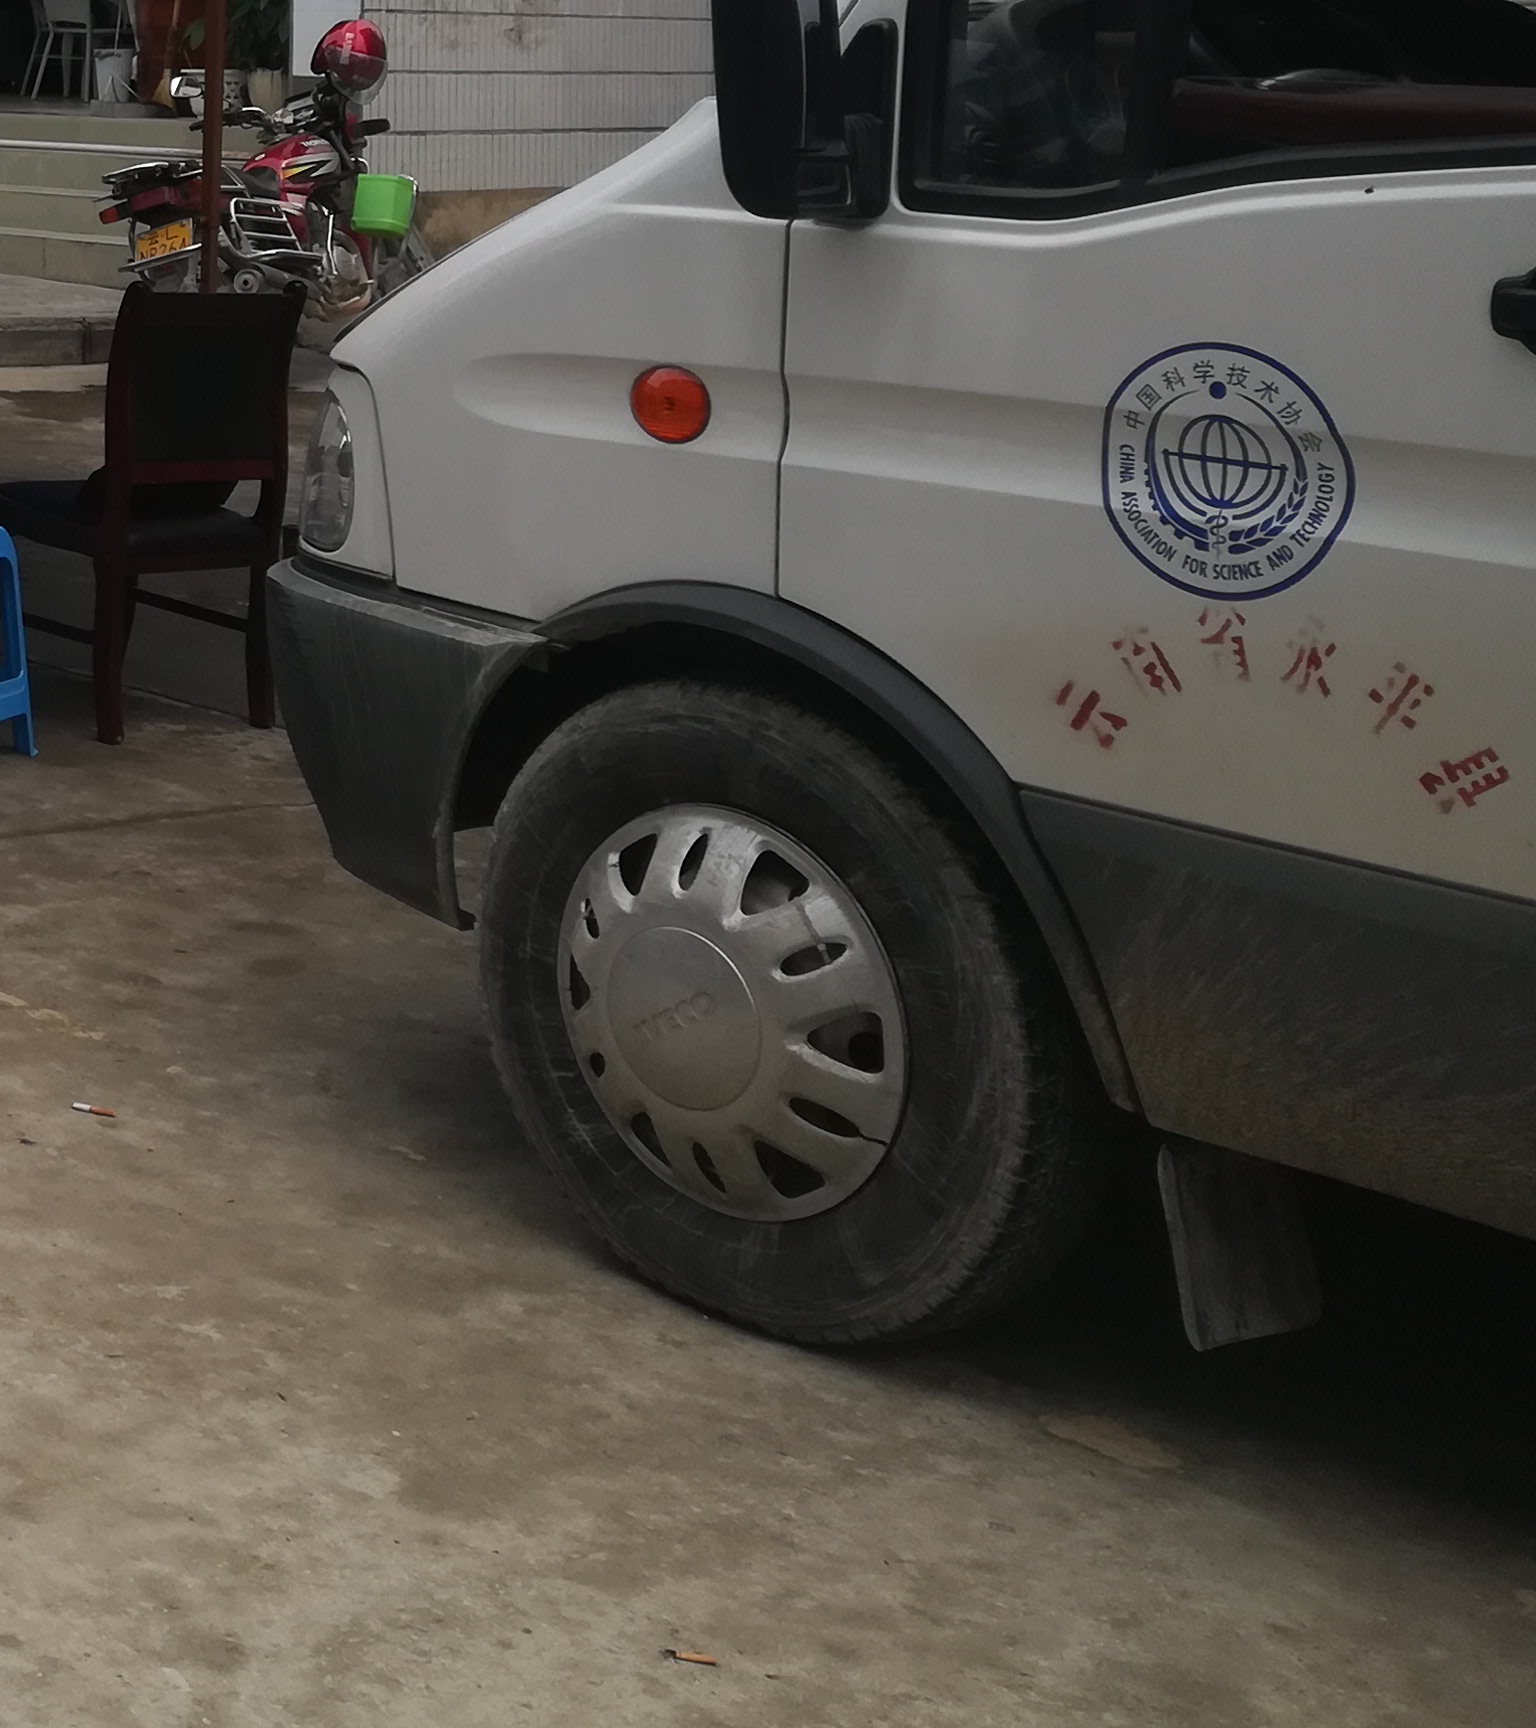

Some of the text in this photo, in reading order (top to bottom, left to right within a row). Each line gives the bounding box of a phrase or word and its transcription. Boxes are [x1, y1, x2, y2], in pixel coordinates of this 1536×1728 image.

[1122, 358, 1324, 454] 中国科学技术协会
[1118, 443, 1338, 582] CHINA ASSOCIATION FOR SCIENCE AND TECHNOLOGY
